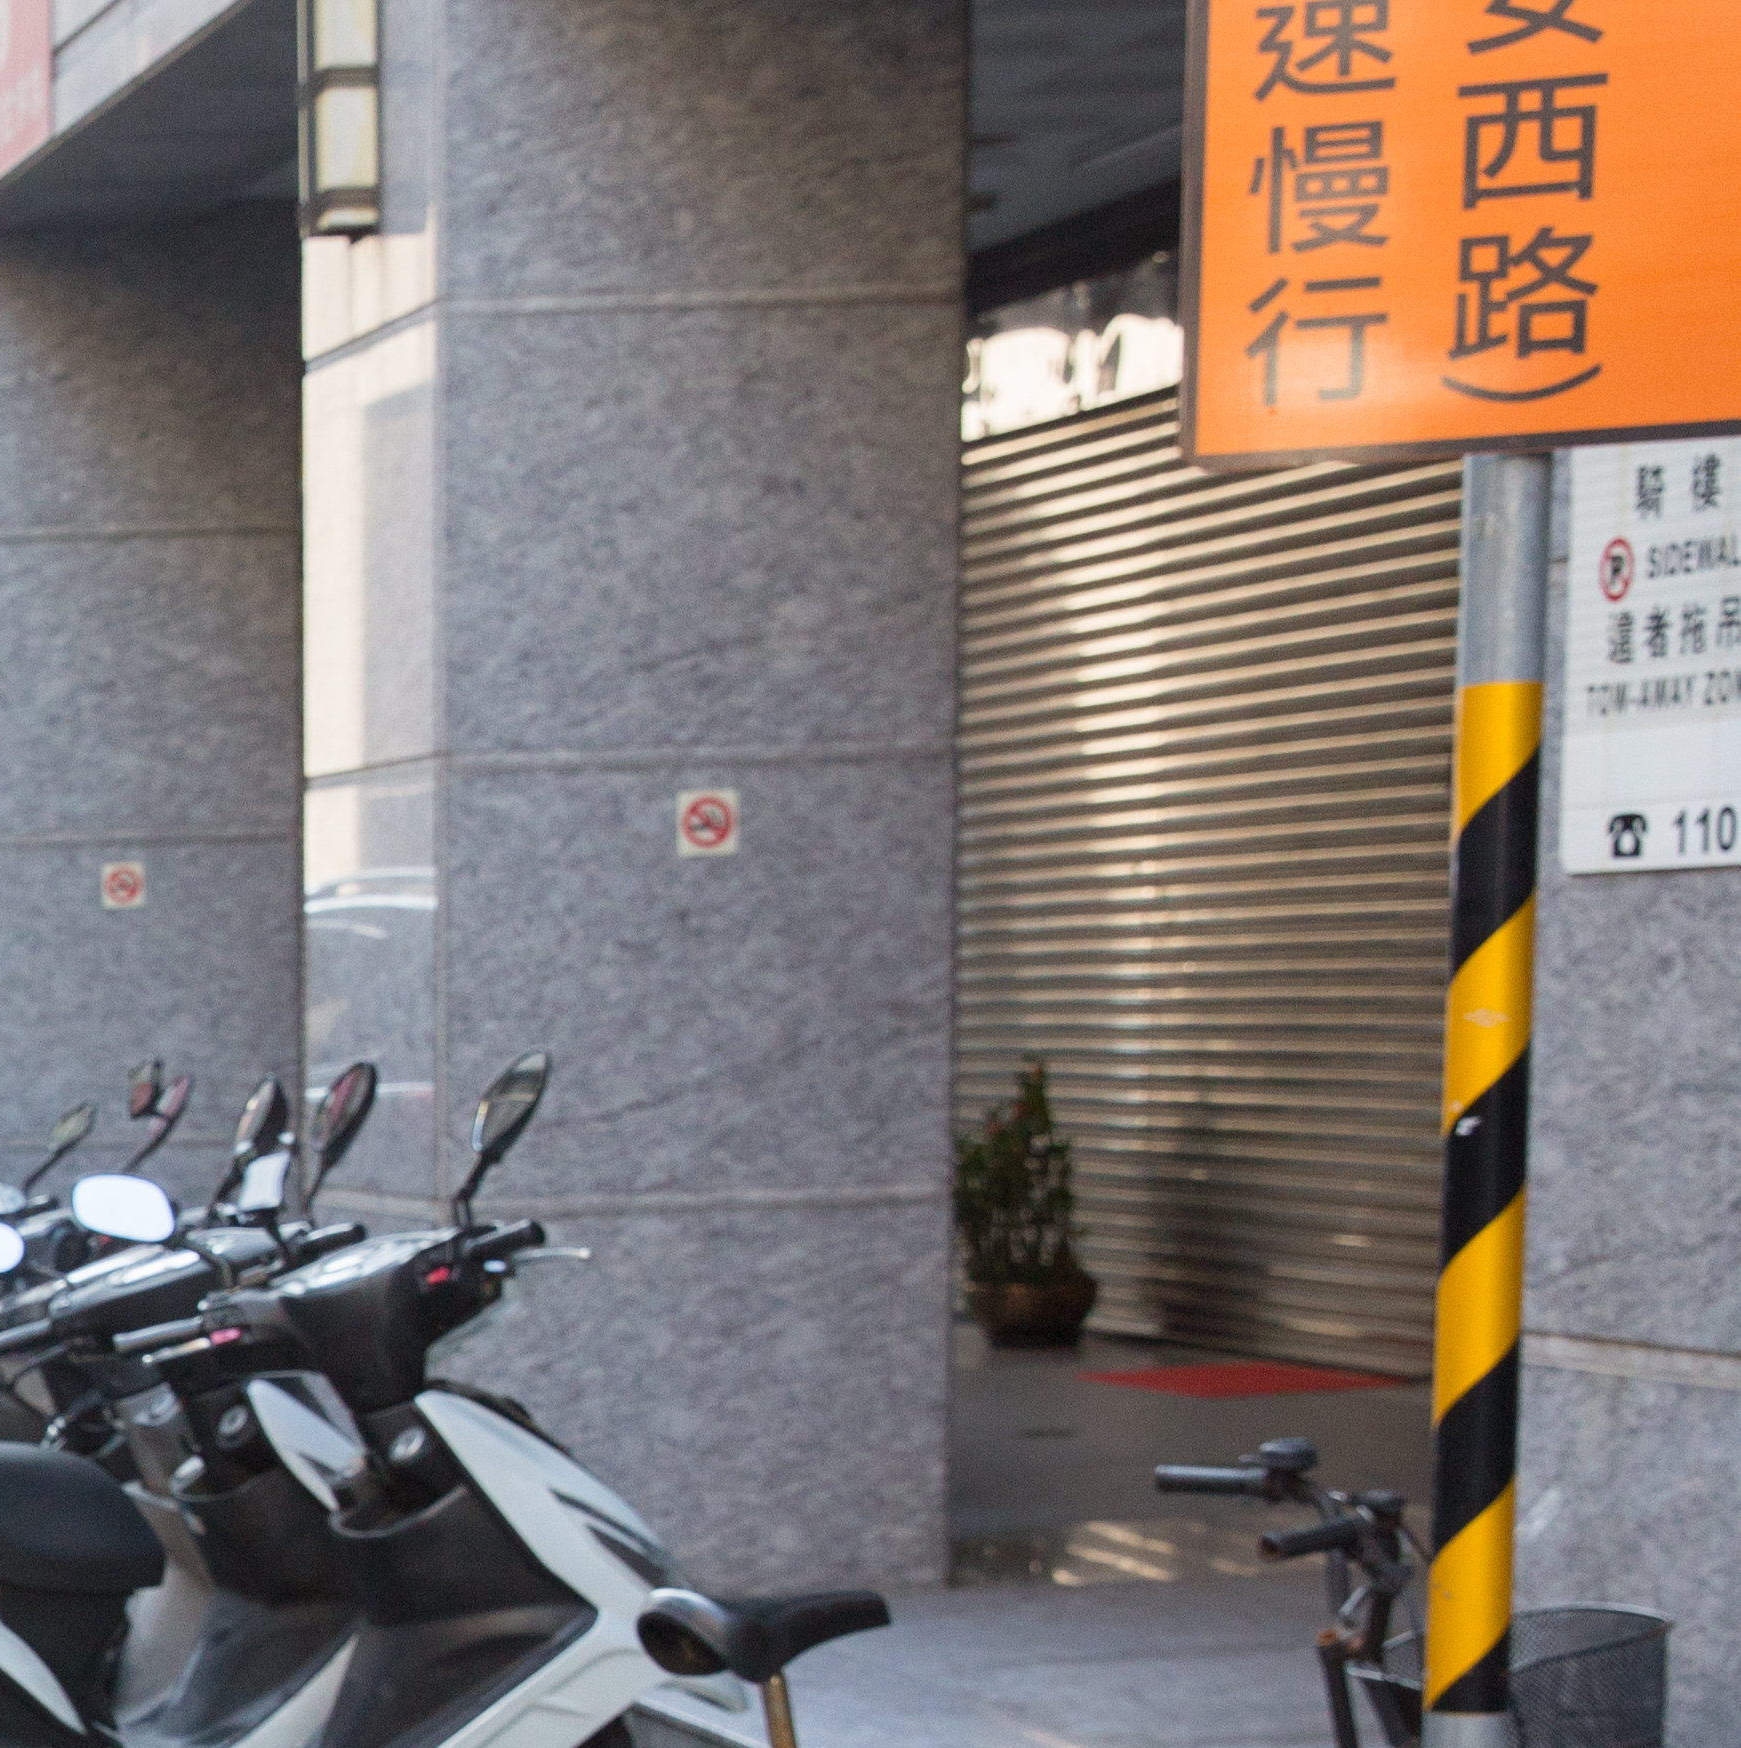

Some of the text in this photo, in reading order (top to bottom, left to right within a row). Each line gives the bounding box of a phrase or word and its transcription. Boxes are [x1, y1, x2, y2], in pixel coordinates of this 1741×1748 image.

[1244, 0, 1398, 406] 速慢行
[1585, 672, 1697, 720] TOW-AWAY
[1673, 806, 1738, 855] 110
